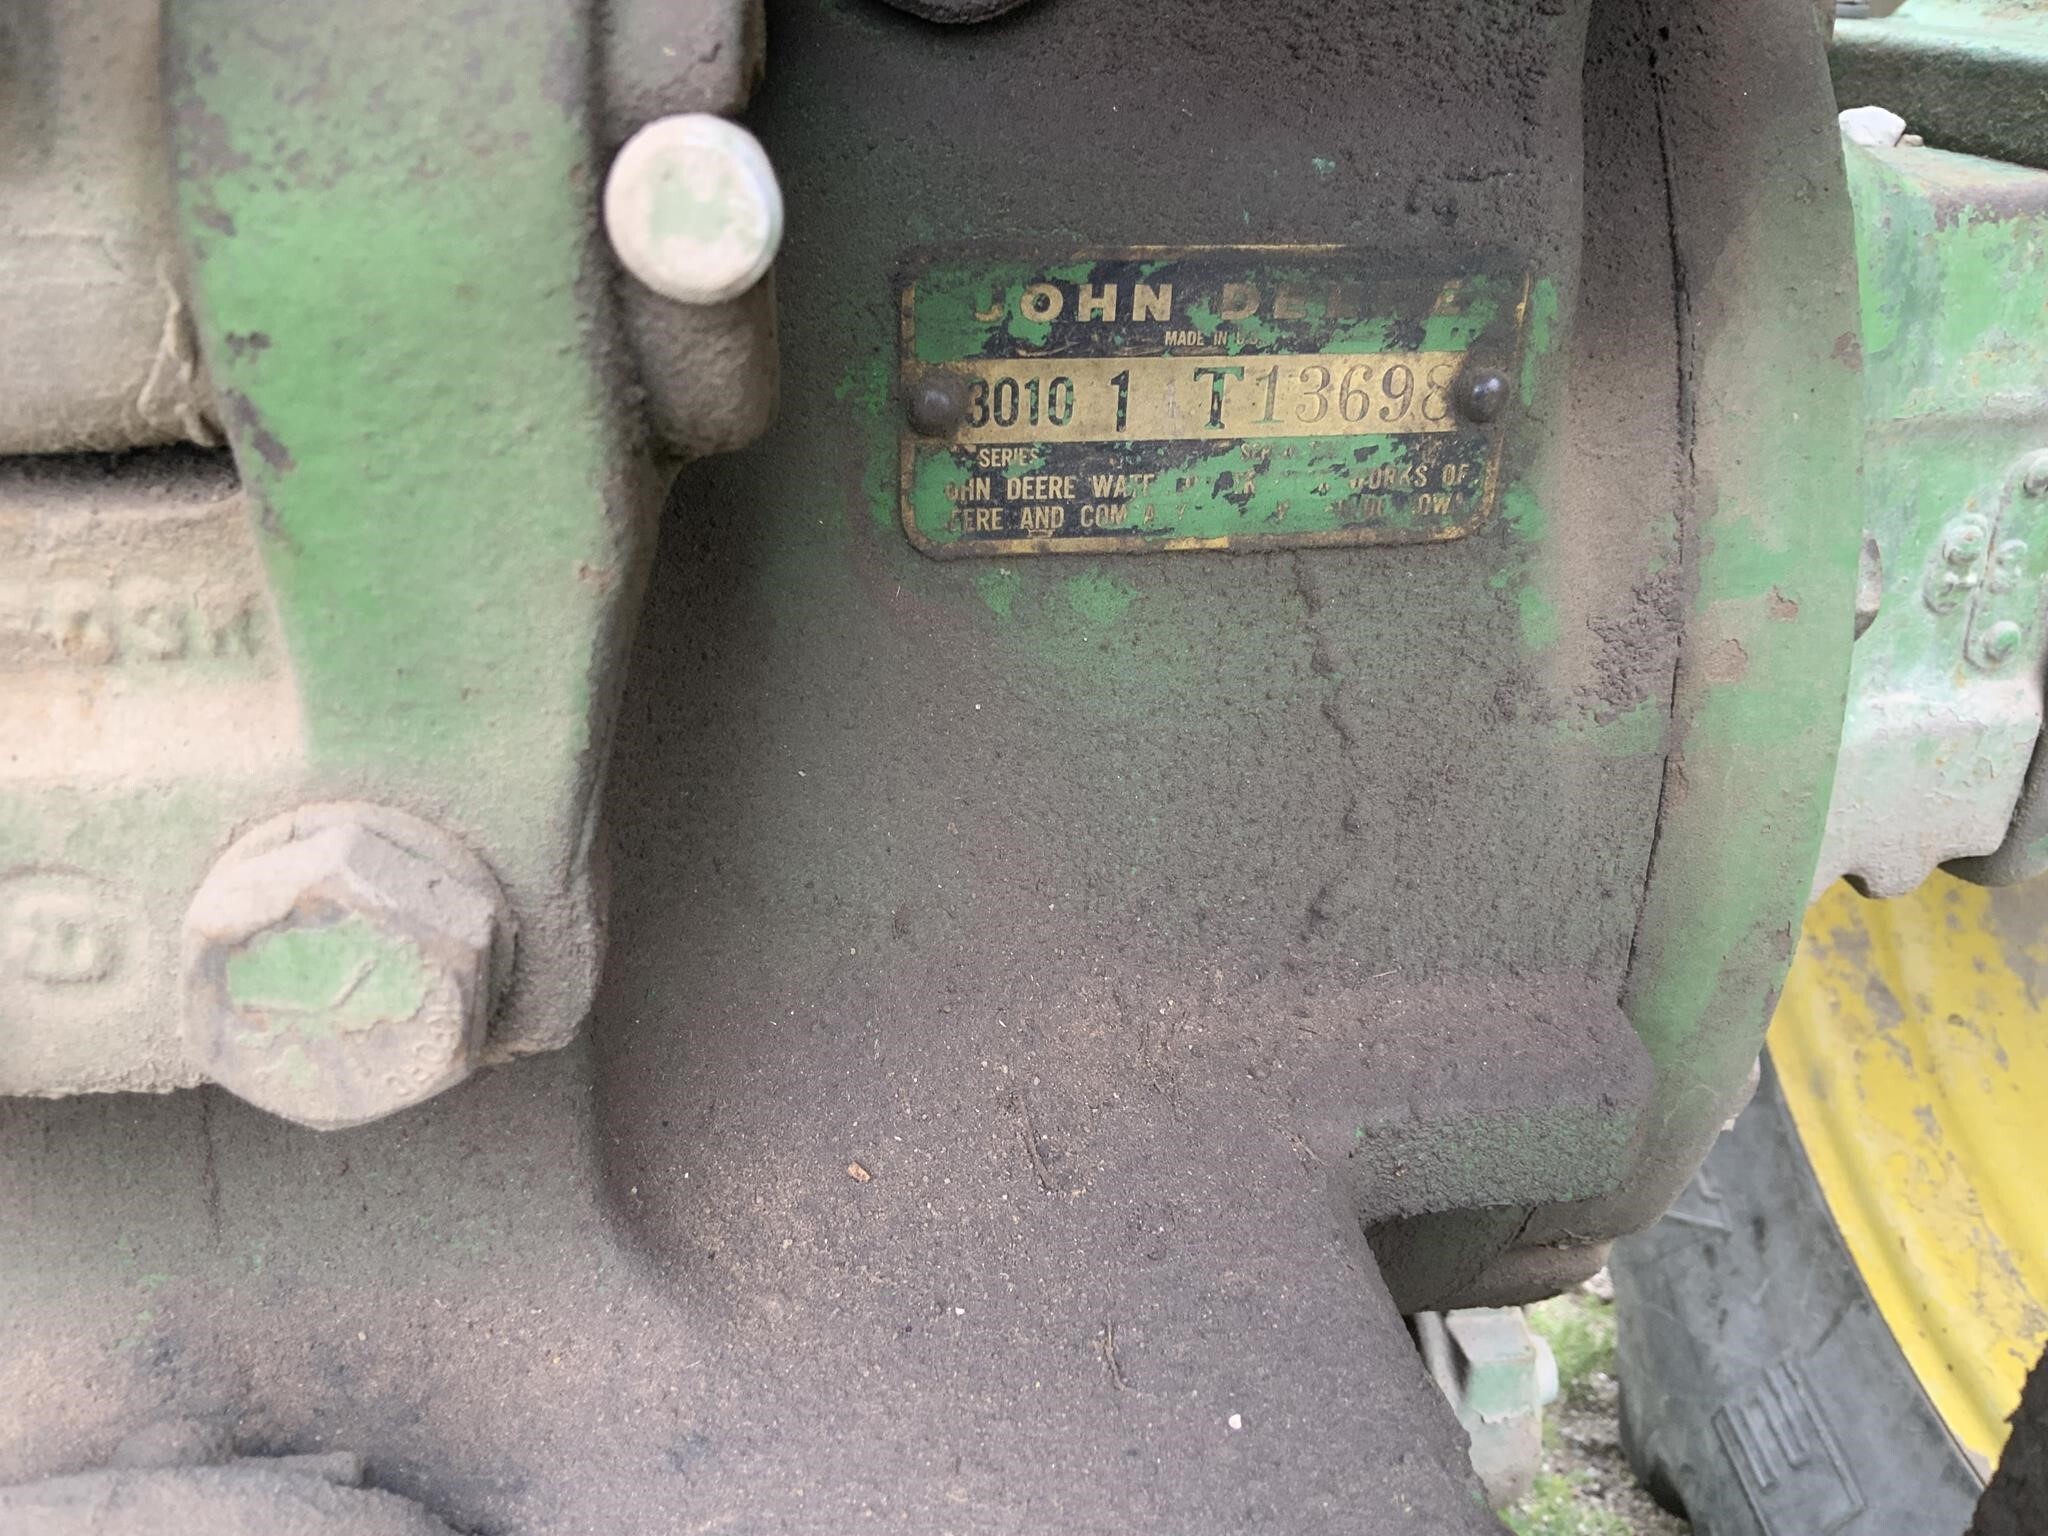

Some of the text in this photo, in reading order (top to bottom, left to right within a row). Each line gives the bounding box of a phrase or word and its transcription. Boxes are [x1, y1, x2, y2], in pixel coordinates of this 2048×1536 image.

[1164, 330, 1205, 346] MADE
[1213, 330, 1228, 346] IN
[966, 375, 1075, 429] 3010
[1110, 369, 1130, 433] 1
[979, 447, 1039, 468] SERIES
[1007, 475, 1076, 500] DEERE
[1019, 506, 1065, 530] AND
